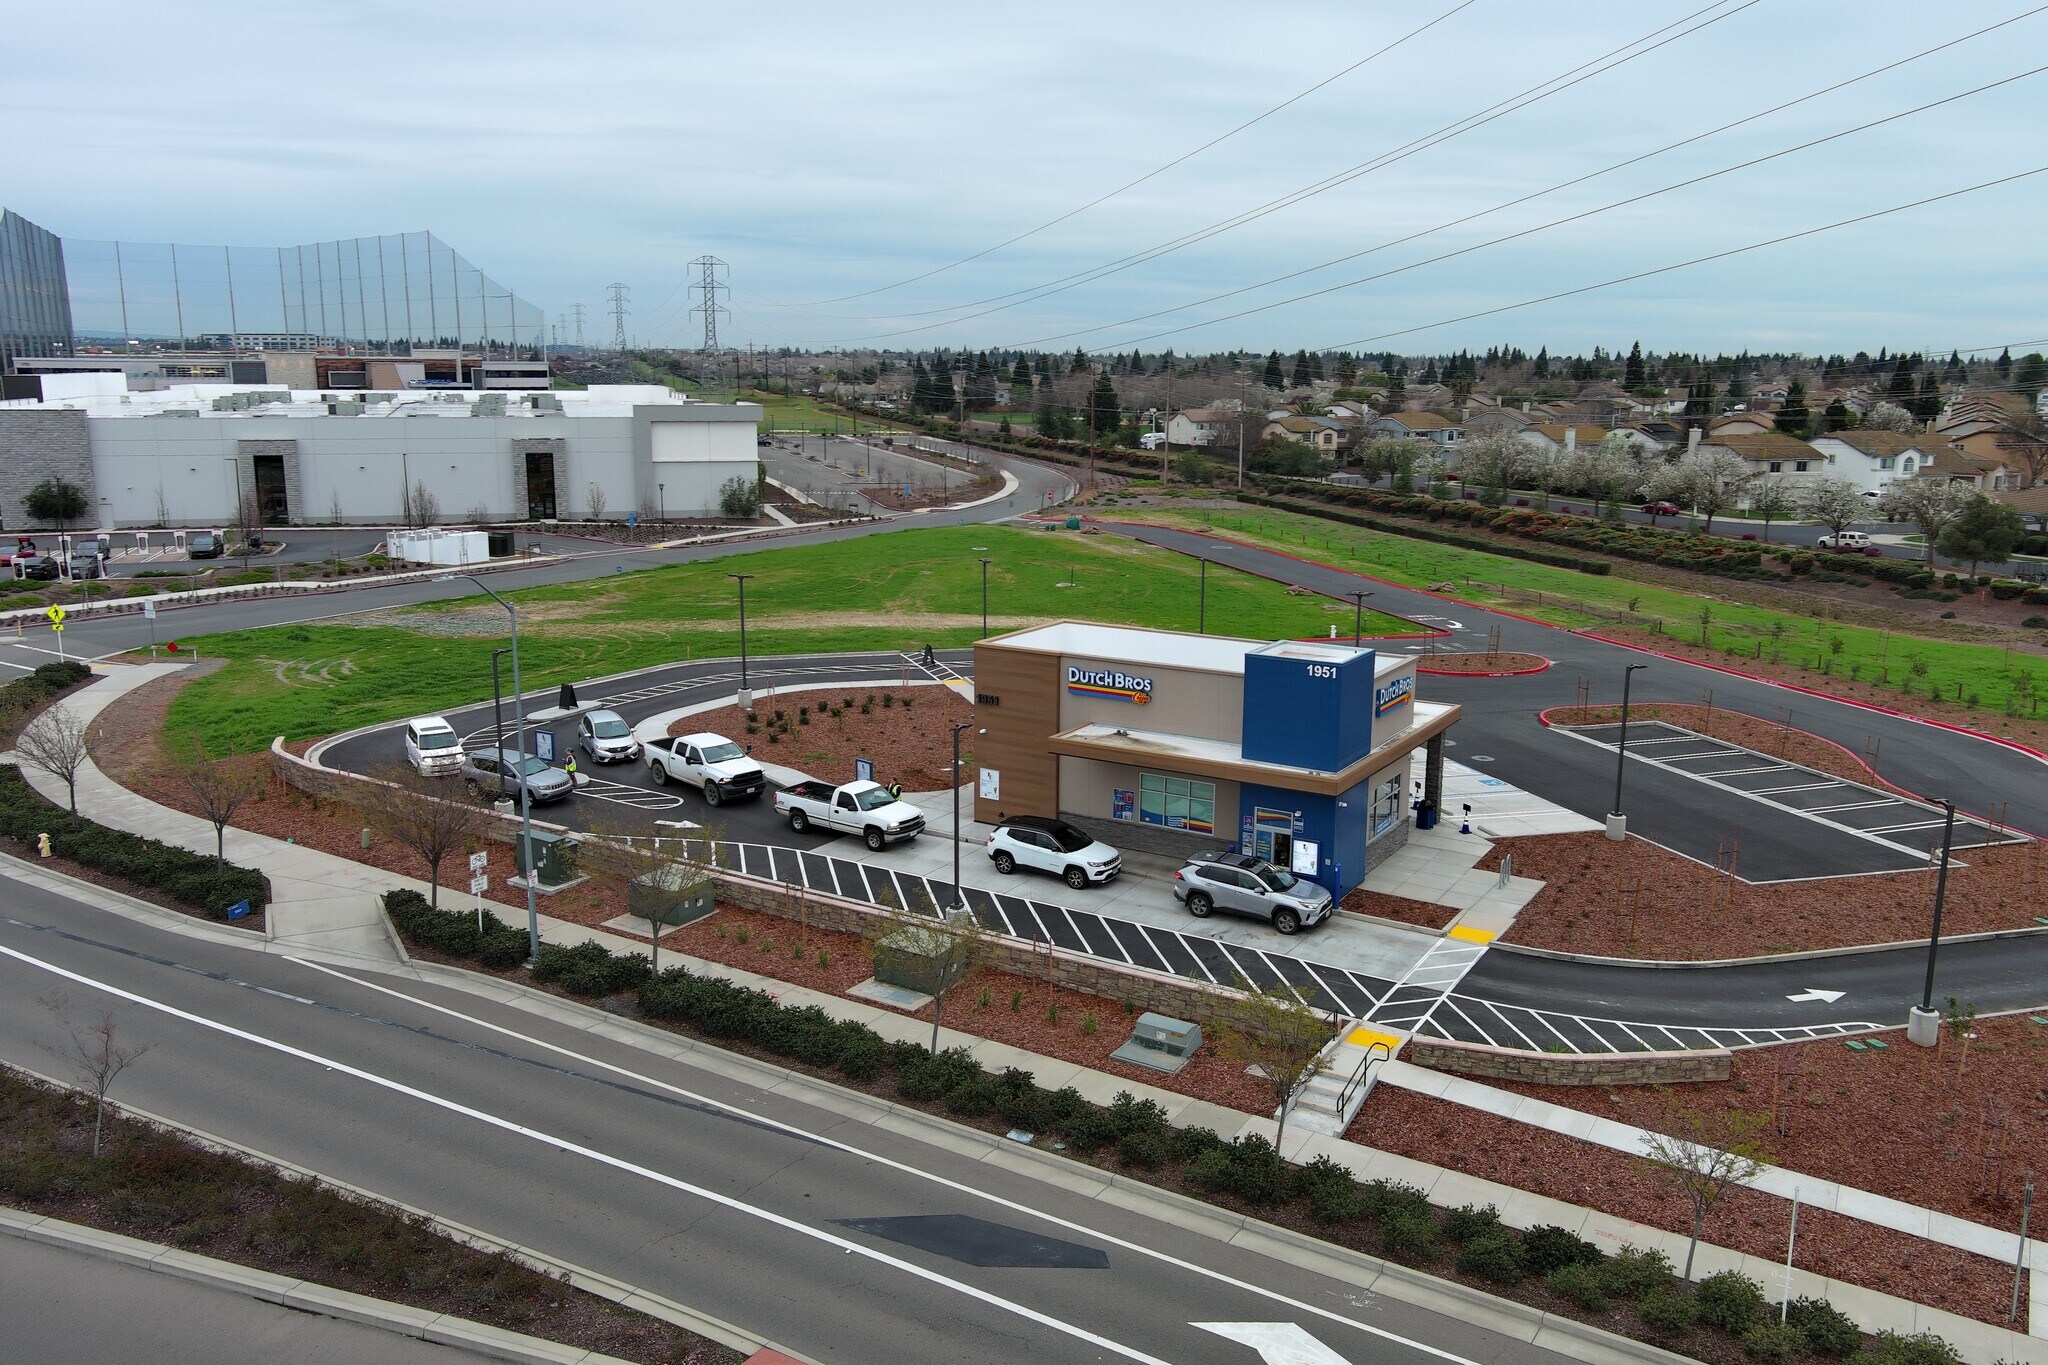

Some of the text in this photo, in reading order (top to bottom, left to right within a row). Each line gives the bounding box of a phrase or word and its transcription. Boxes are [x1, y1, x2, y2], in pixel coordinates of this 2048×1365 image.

[1307, 664, 1337, 679] 1951
[1115, 672, 1152, 691] BROS
[976, 693, 999, 706] 1951
